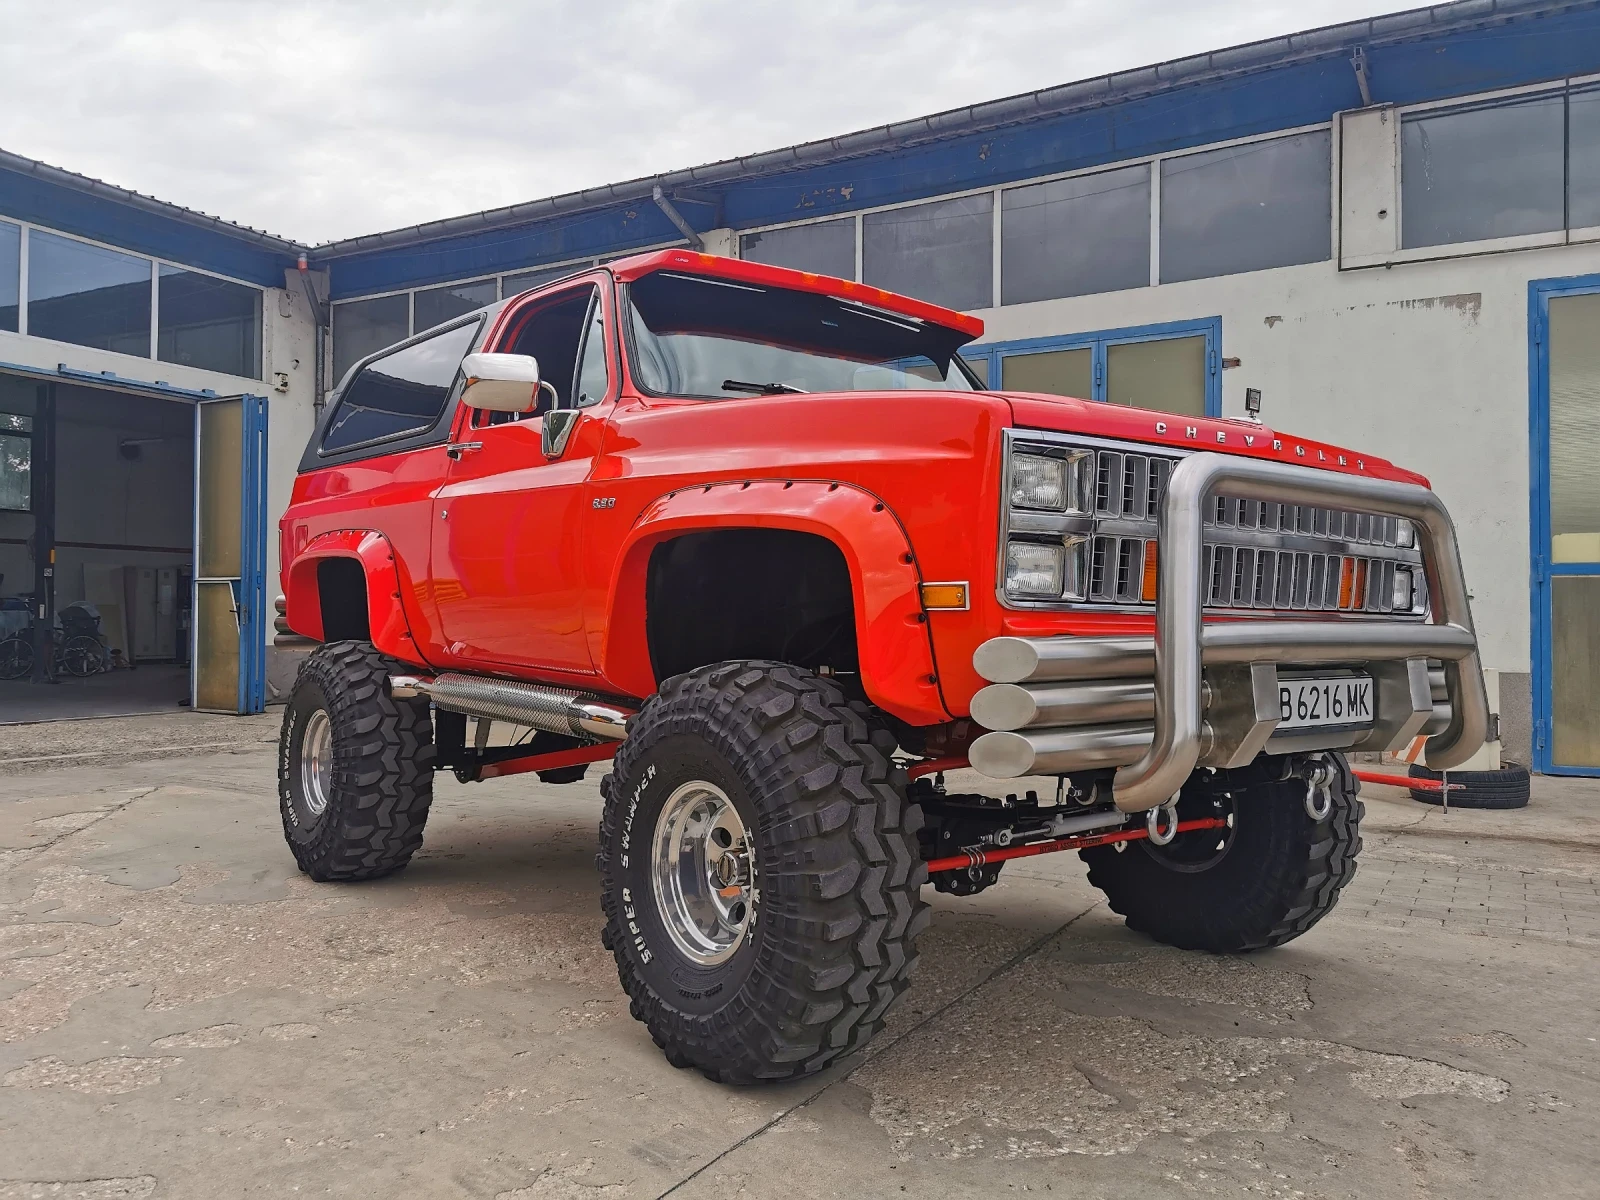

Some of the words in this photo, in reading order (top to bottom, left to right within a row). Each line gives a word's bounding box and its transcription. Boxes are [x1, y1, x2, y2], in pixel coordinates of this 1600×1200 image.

[1155, 422, 1364, 470] CHEVROLET
[1297, 684, 1343, 721] 6216
[1346, 683, 1370, 717] MK
[285, 790, 299, 827] SUPER
[620, 764, 656, 869] SWAMPER
[622, 887, 654, 965] SUPER
